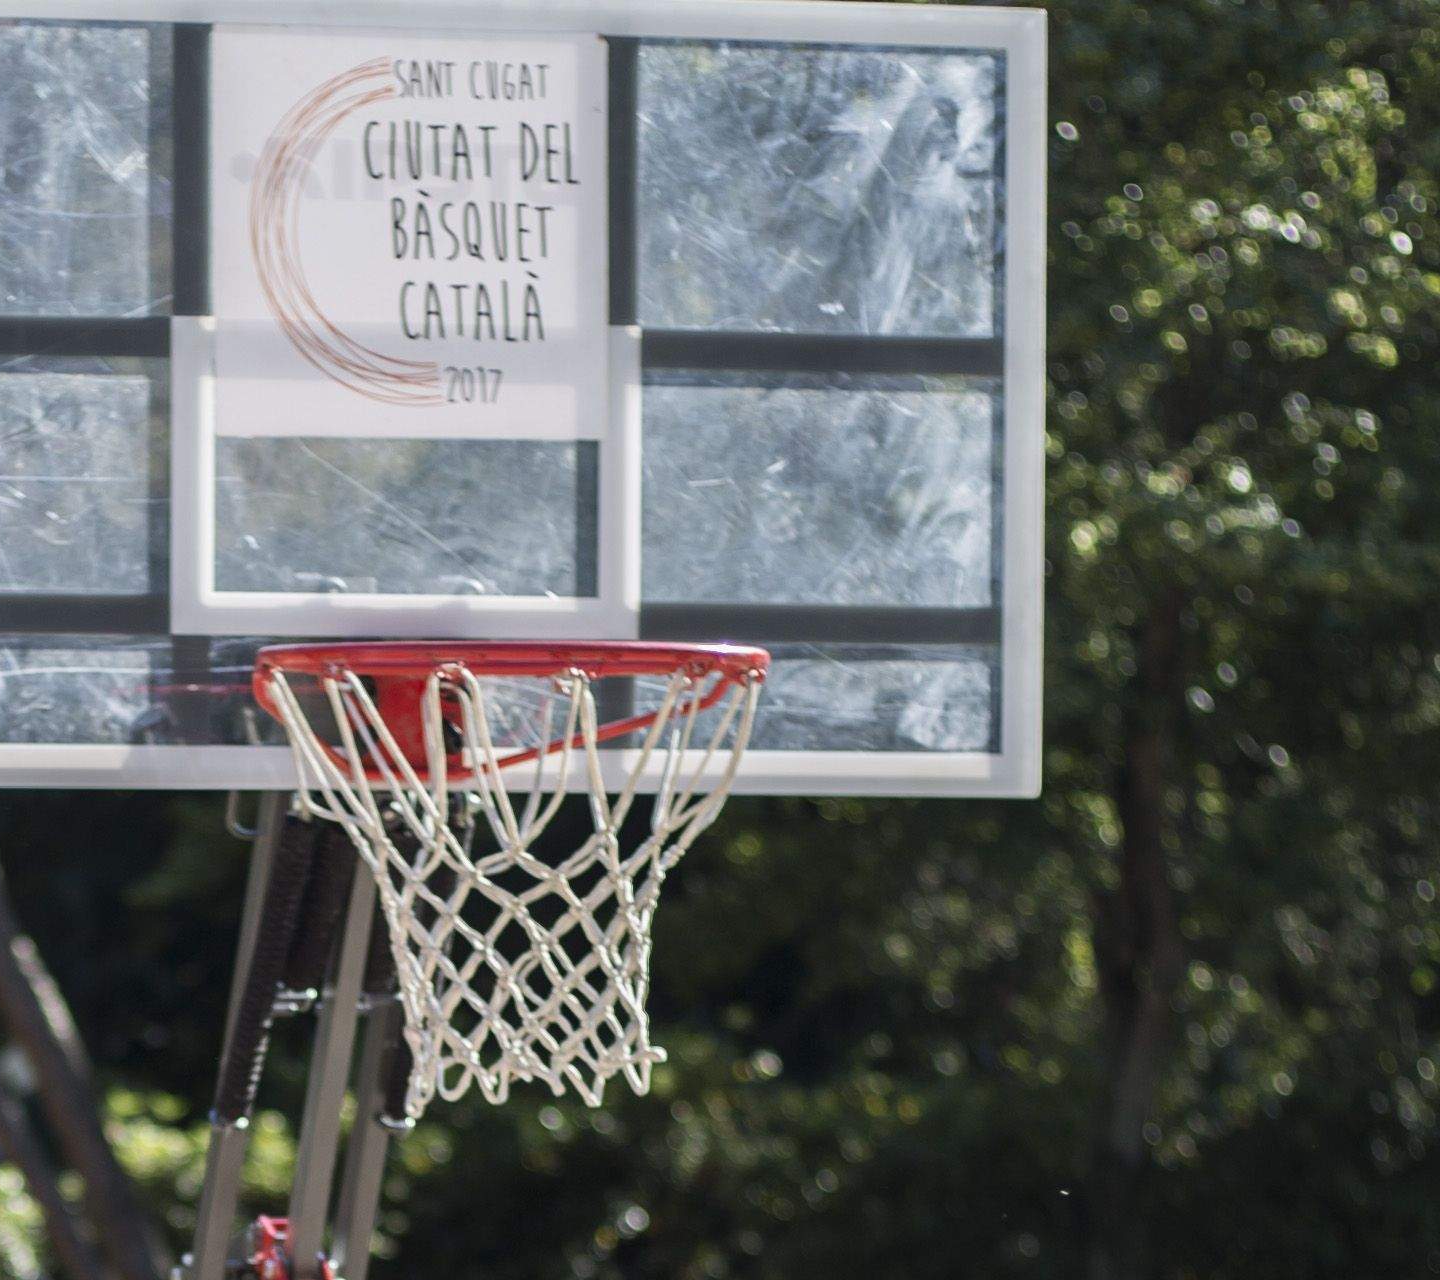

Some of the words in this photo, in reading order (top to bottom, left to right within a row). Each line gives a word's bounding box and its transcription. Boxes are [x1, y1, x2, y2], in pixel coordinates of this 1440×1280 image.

[393, 61, 456, 98] SANT
[470, 61, 550, 98] CUGAT
[365, 121, 497, 181] CIUTAT
[521, 122, 580, 184] DEL
[391, 190, 553, 261] BÀSQUET
[400, 272, 545, 341] CATALÀ
[445, 367, 503, 402] 2017
